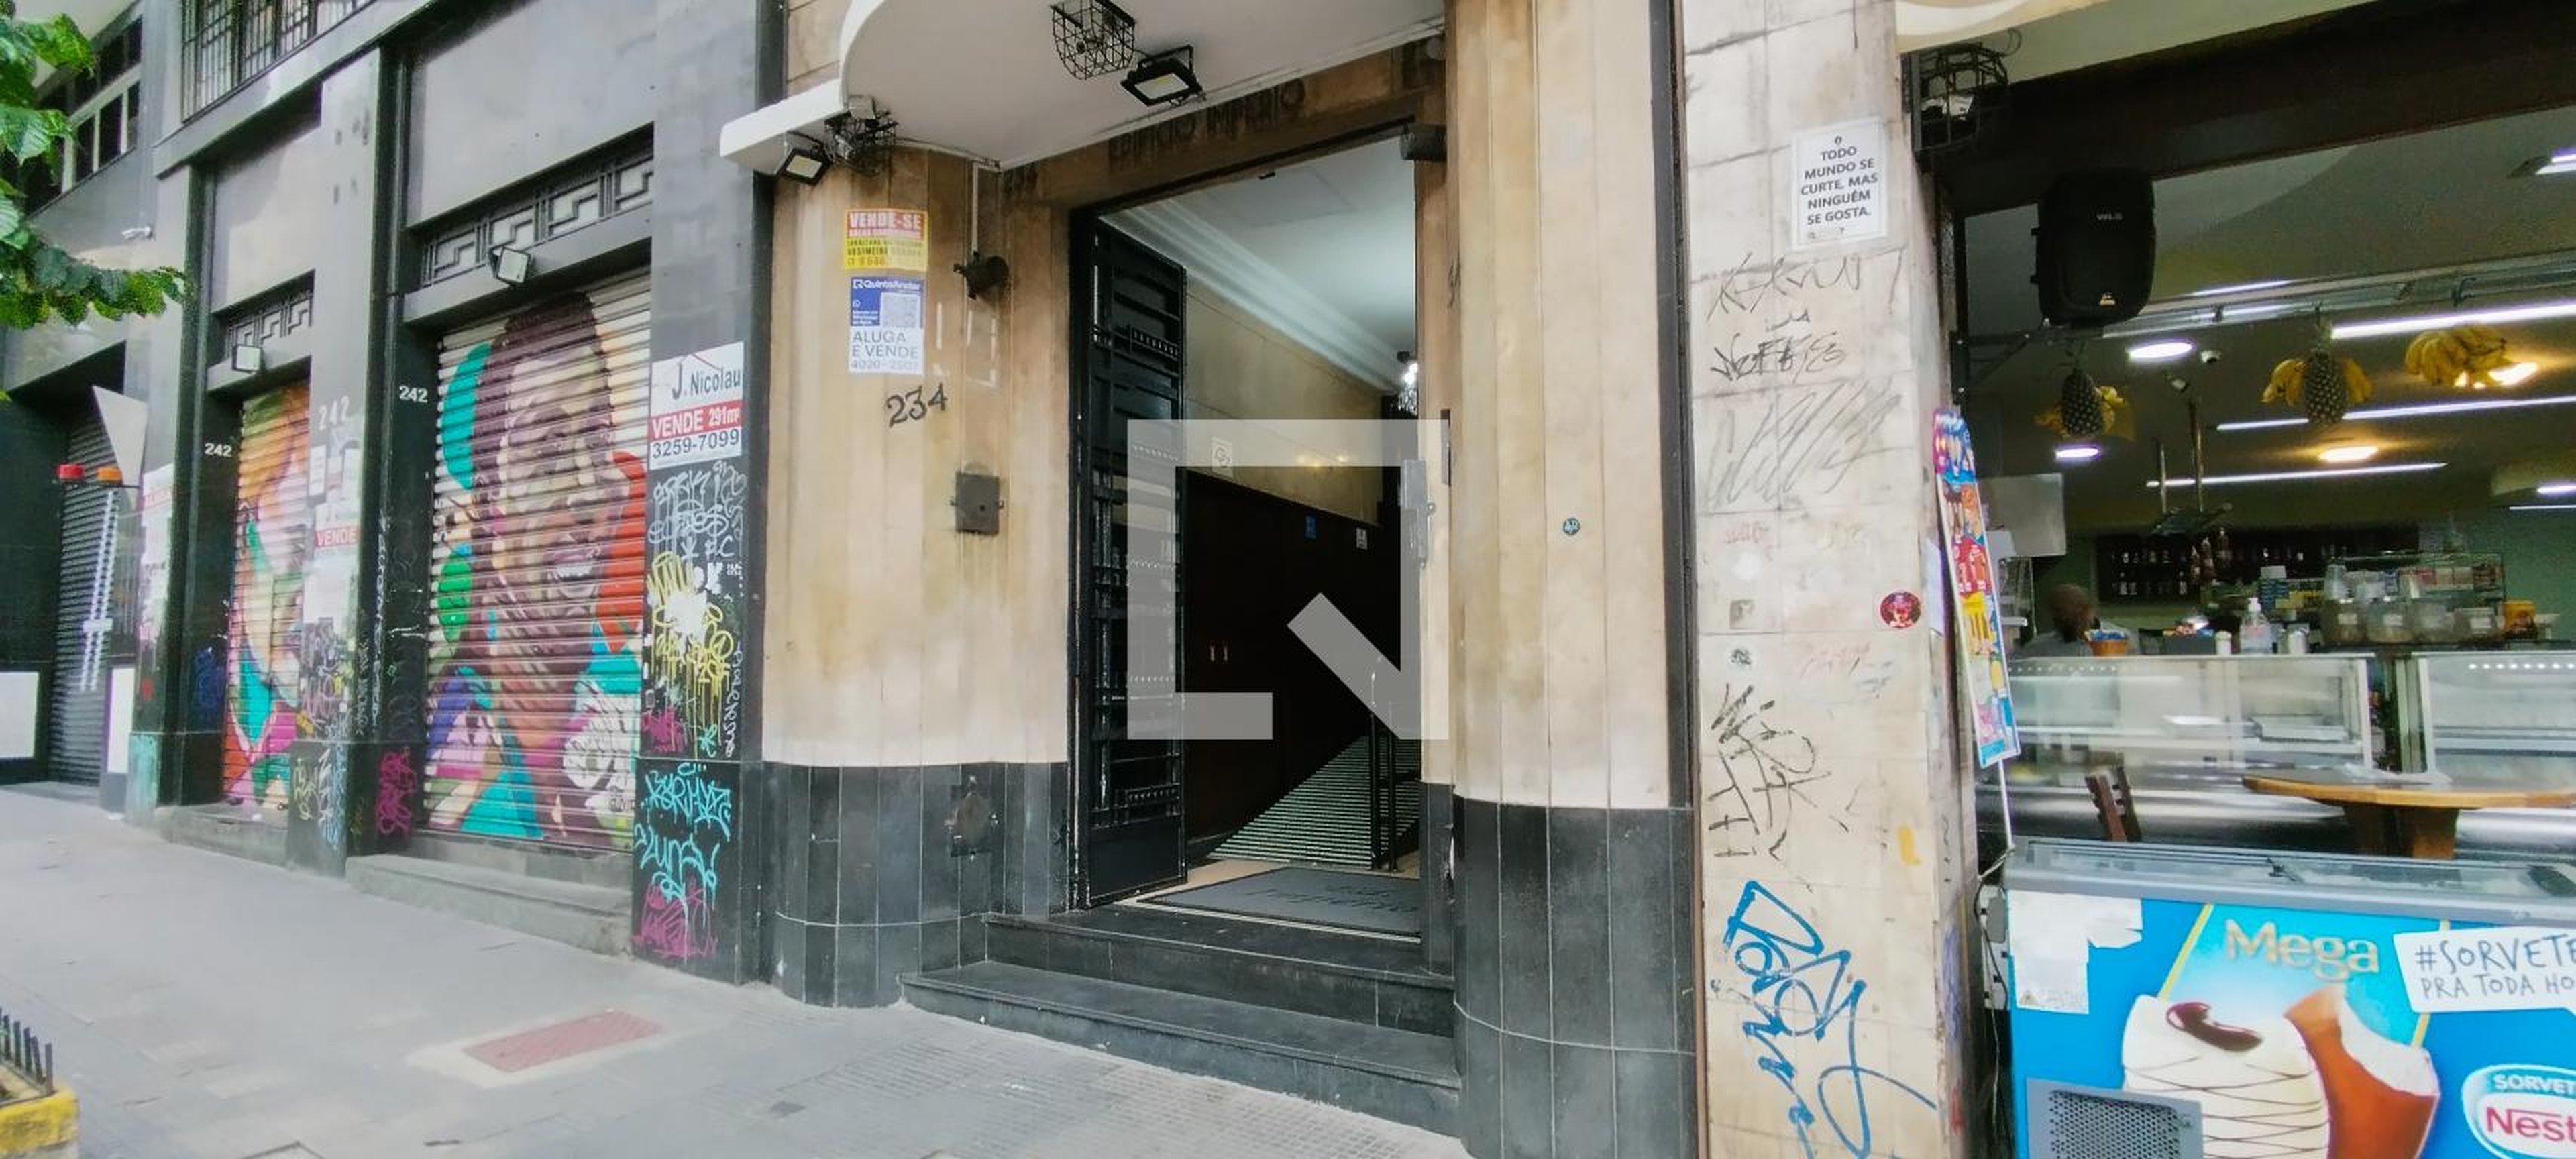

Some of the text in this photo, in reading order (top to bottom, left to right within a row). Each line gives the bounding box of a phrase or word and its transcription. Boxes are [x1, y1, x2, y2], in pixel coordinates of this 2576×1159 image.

[1821, 146, 1857, 161] TODO
[1805, 158, 1875, 180] MUNDO SE
[1849, 172, 1878, 187] MAS
[1808, 190, 1871, 209] NINGUÉM
[849, 212, 922, 230] VENDE-SE
[1807, 213, 1821, 225] SE
[853, 331, 906, 343] ALUGA
[852, 345, 918, 359] E VENDE
[690, 367, 741, 396] Nicolau
[399, 386, 428, 403] 242
[319, 396, 350, 431] 242
[887, 382, 948, 428] 234
[652, 410, 704, 439] VENDE
[205, 443, 233, 457] 242
[653, 428, 739, 459] 3259-7099
[316, 529, 357, 547] VENDE
[2224, 918, 2380, 983] Mega
[2421, 973, 2575, 999] PRA TODA HO
